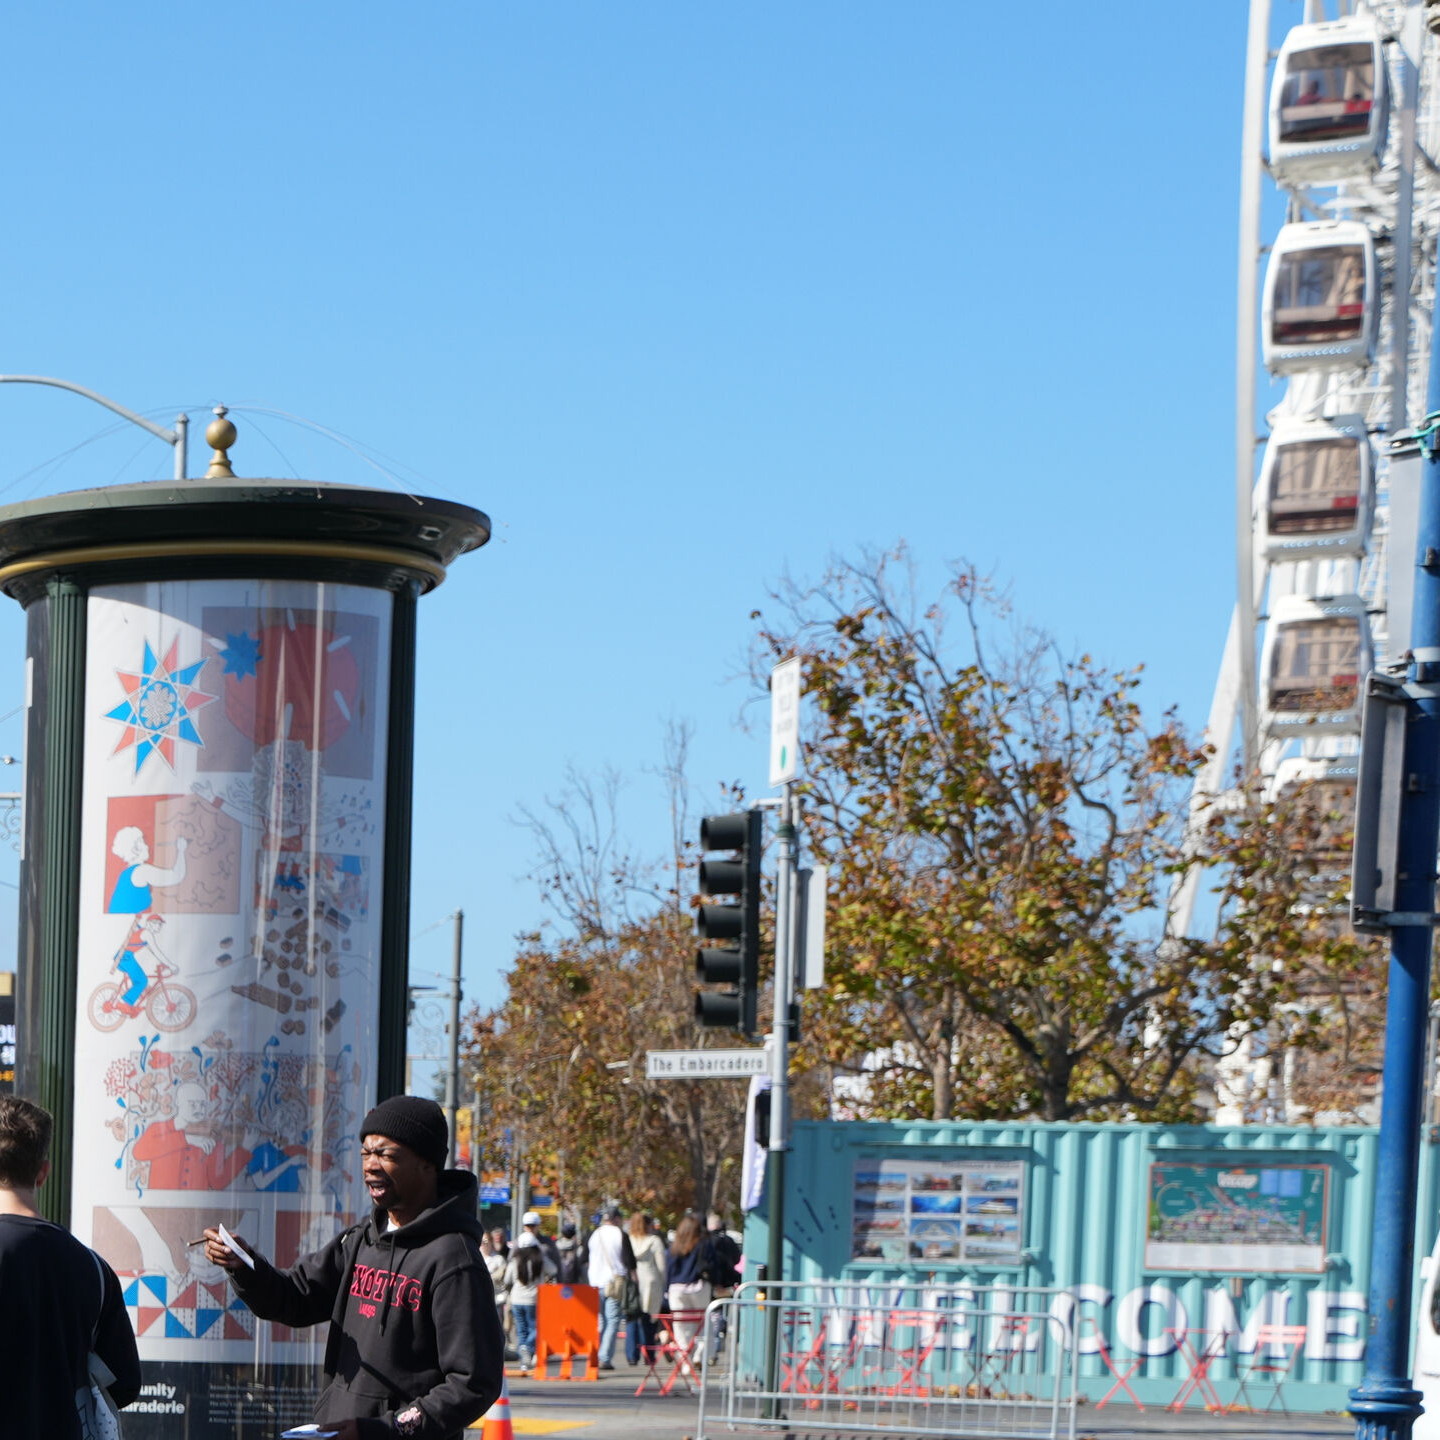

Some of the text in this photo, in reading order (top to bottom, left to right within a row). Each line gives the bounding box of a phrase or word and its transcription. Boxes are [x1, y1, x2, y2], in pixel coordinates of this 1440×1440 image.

[653, 1056, 763, 1072] The Embarcadero
[810, 1278, 1368, 1362] WELCOME
